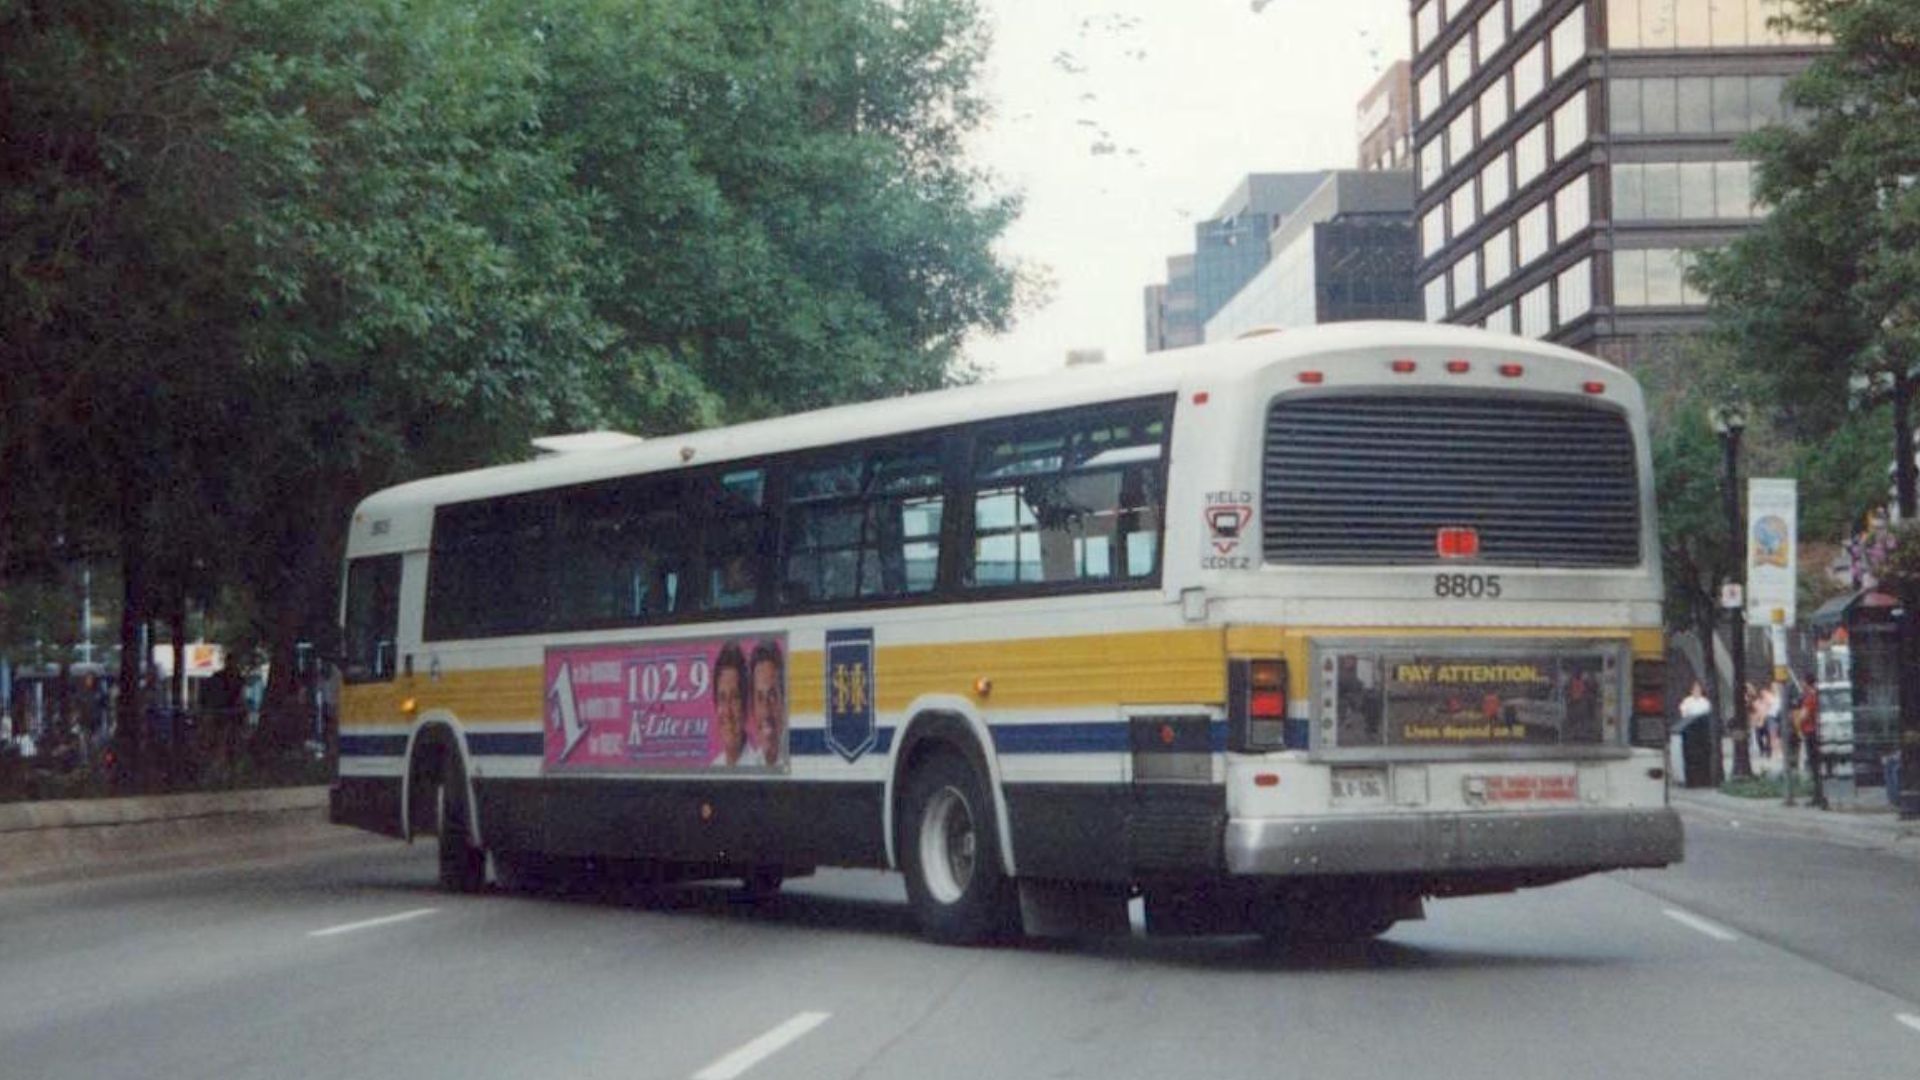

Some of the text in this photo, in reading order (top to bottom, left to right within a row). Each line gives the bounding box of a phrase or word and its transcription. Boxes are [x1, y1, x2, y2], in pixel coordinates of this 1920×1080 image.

[1204, 490, 1252, 504] YIELD
[1434, 572, 1502, 598] 8805
[627, 660, 709, 703] 102.9
[1398, 664, 1432, 683] PAY
